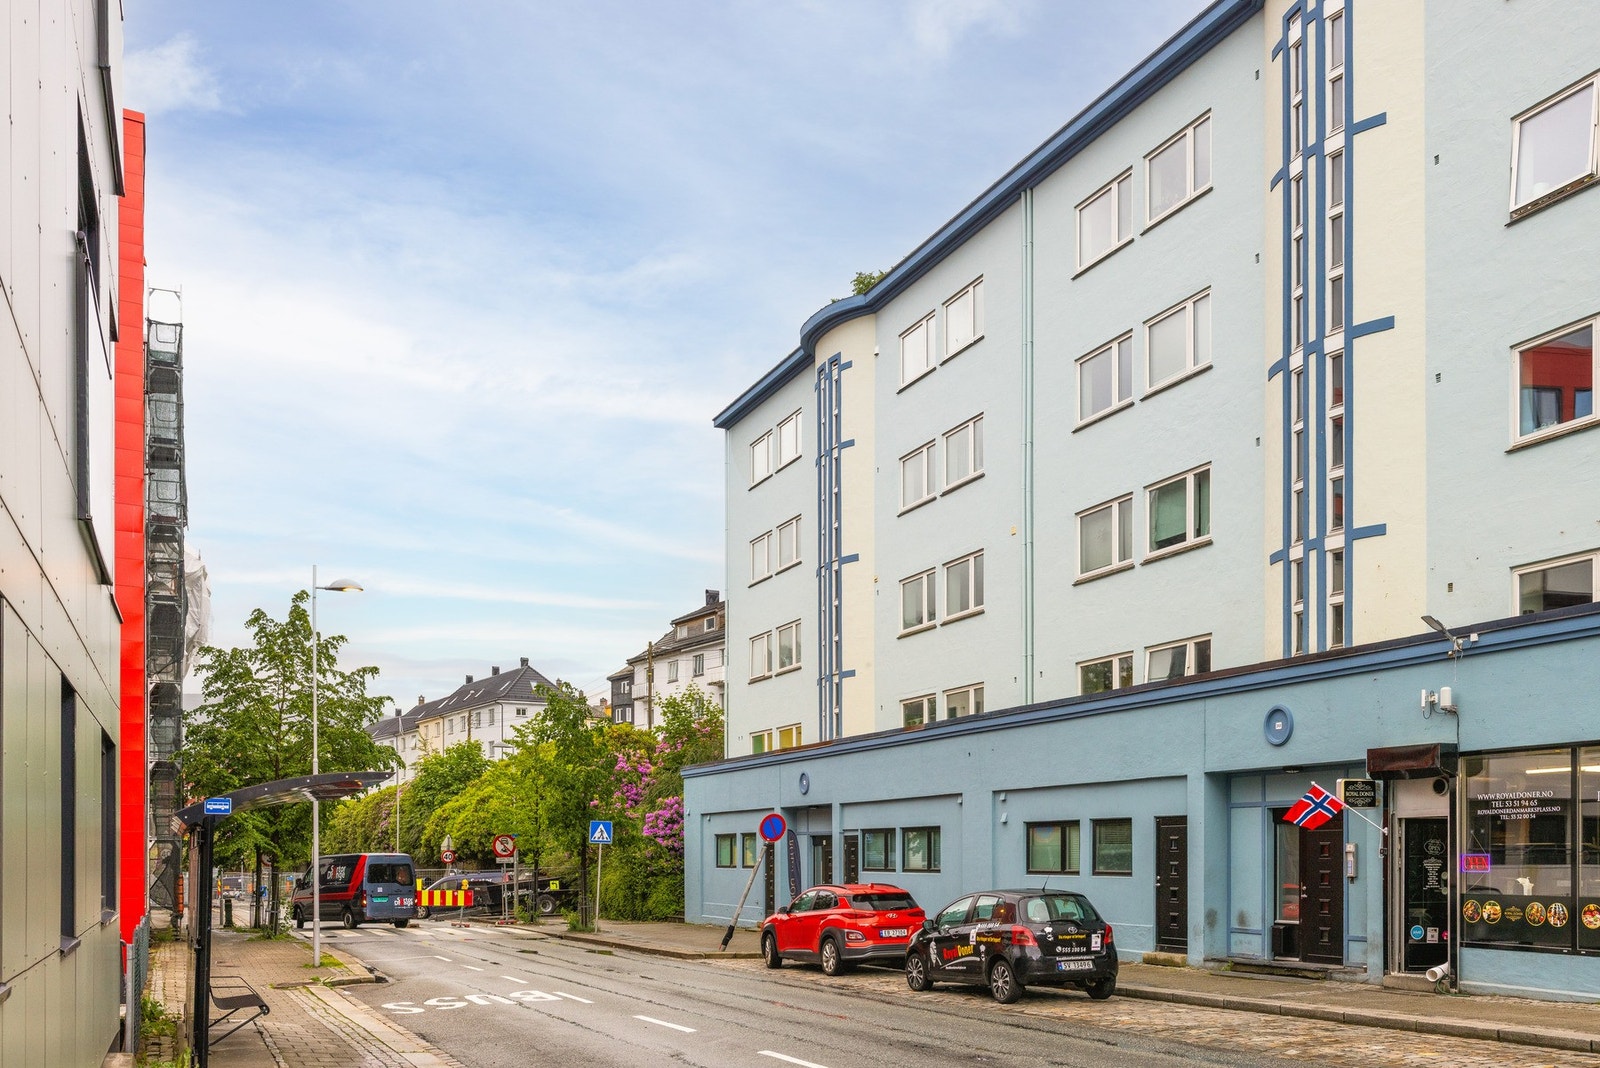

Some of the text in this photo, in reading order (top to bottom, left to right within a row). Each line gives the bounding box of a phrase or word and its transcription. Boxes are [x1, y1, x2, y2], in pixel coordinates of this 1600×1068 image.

[1477, 791, 1553, 800] WWW.ROYALDONER.NO
[1530, 799, 1537, 807] 65
[1464, 856, 1488, 870] OPEN
[1073, 961, 1091, 969] 13496
[381, 990, 562, 1014] BUSS
